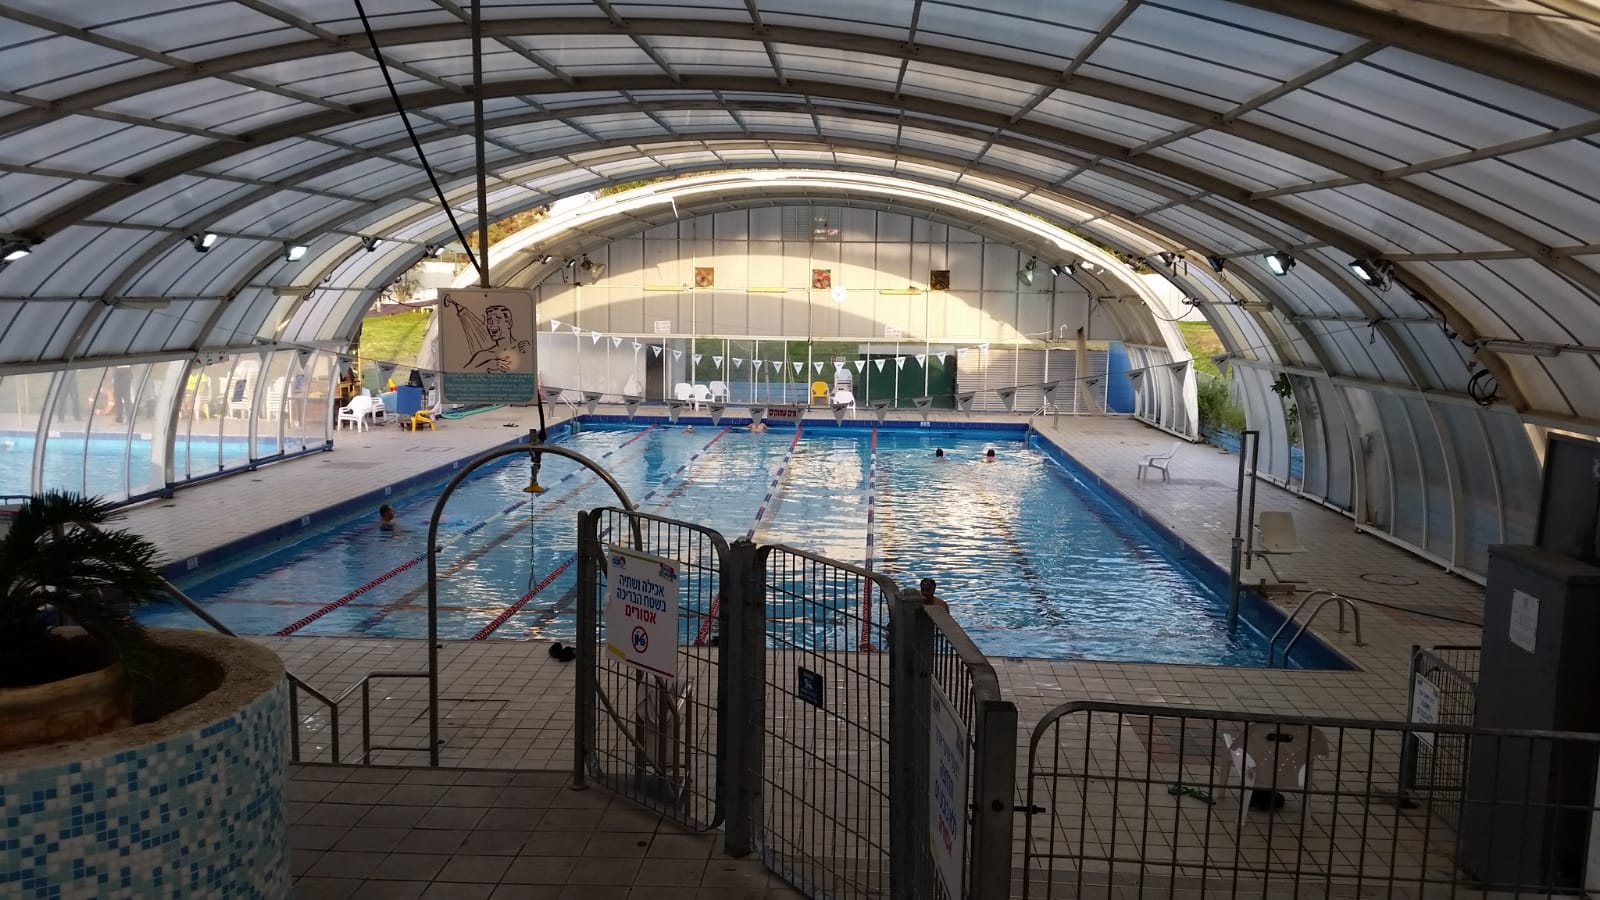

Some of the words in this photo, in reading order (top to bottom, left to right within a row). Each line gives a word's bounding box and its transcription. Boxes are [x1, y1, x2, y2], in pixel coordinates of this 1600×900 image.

[619, 574, 641, 591] ושתיה
[641, 579, 665, 598] אכילה
[616, 587, 642, 606] הבריכה
[643, 595, 667, 613] בשטח
[625, 604, 657, 625] אסורים
